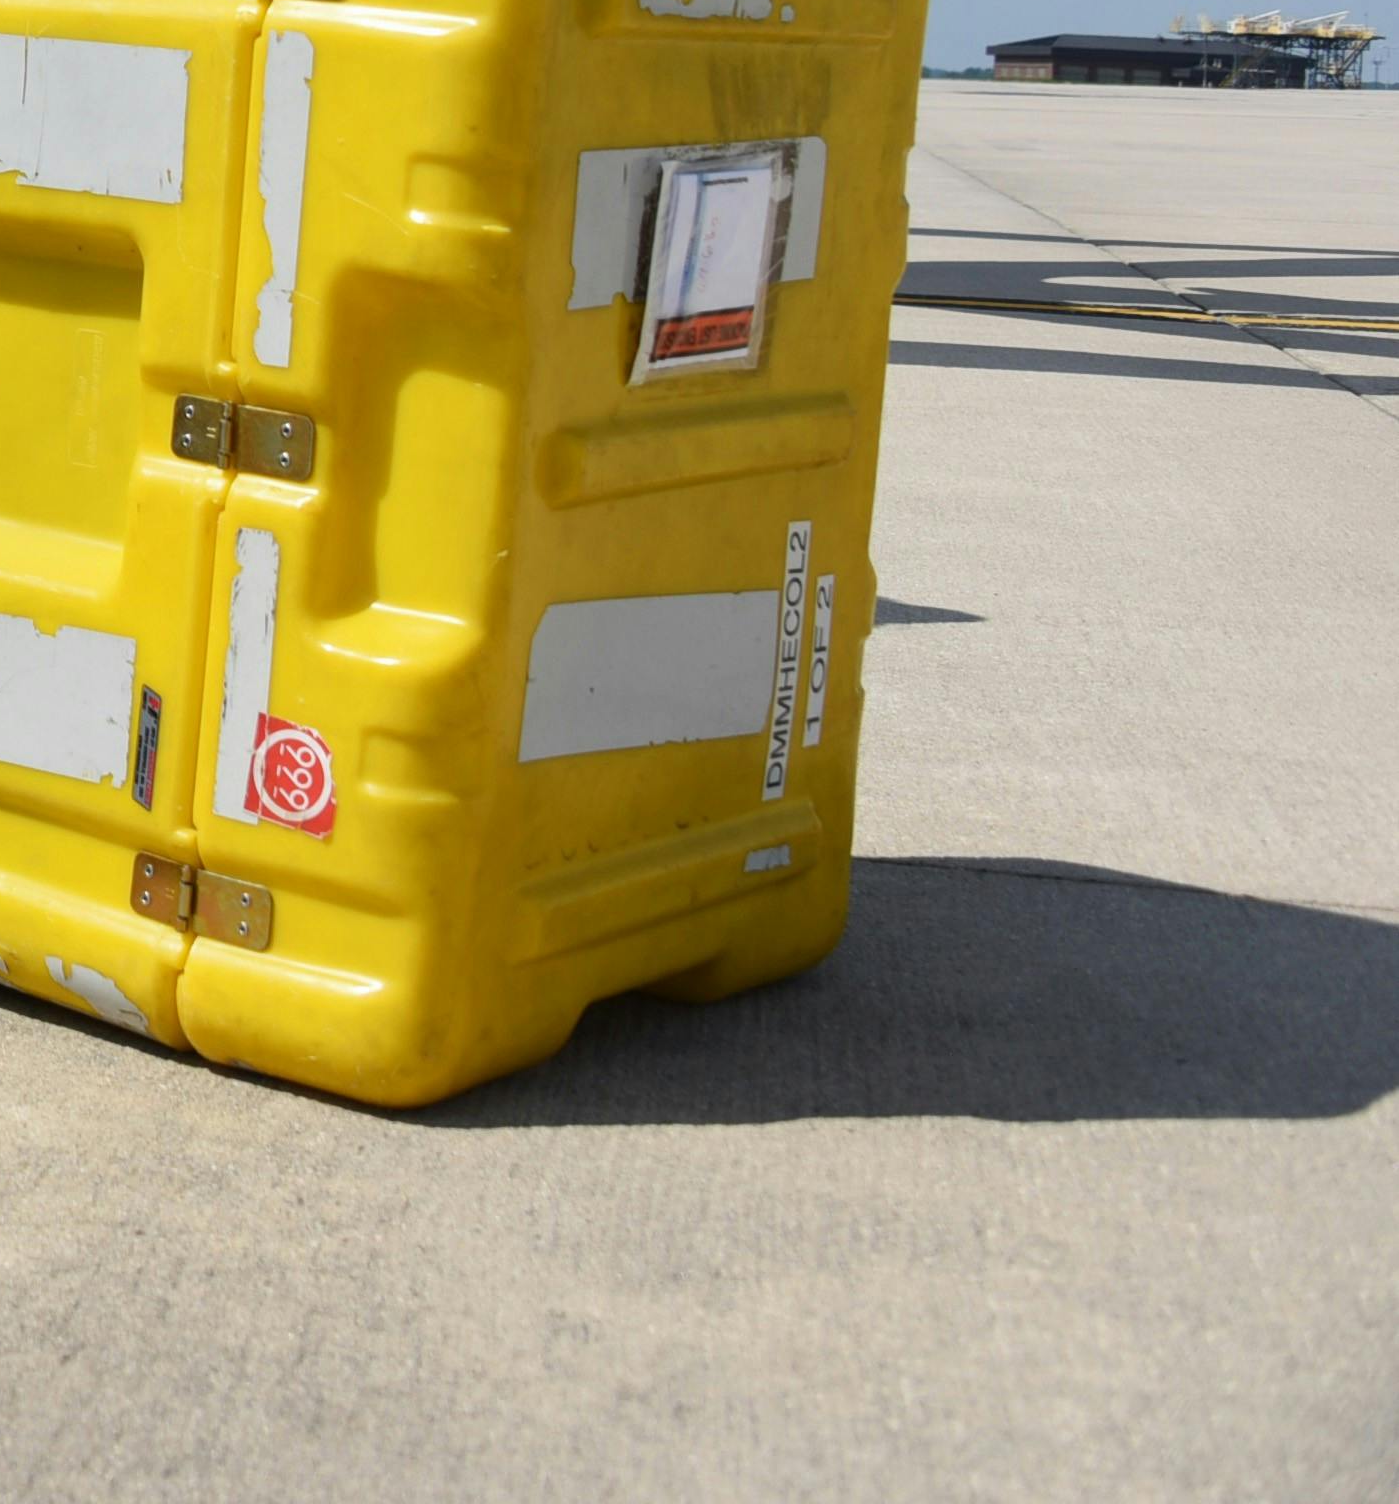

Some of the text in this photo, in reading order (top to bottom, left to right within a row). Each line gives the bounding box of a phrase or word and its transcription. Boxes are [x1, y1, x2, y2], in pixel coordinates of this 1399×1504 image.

[766, 529, 807, 790] DMMHECOL2
[806, 582, 833, 732] 1 OF 2
